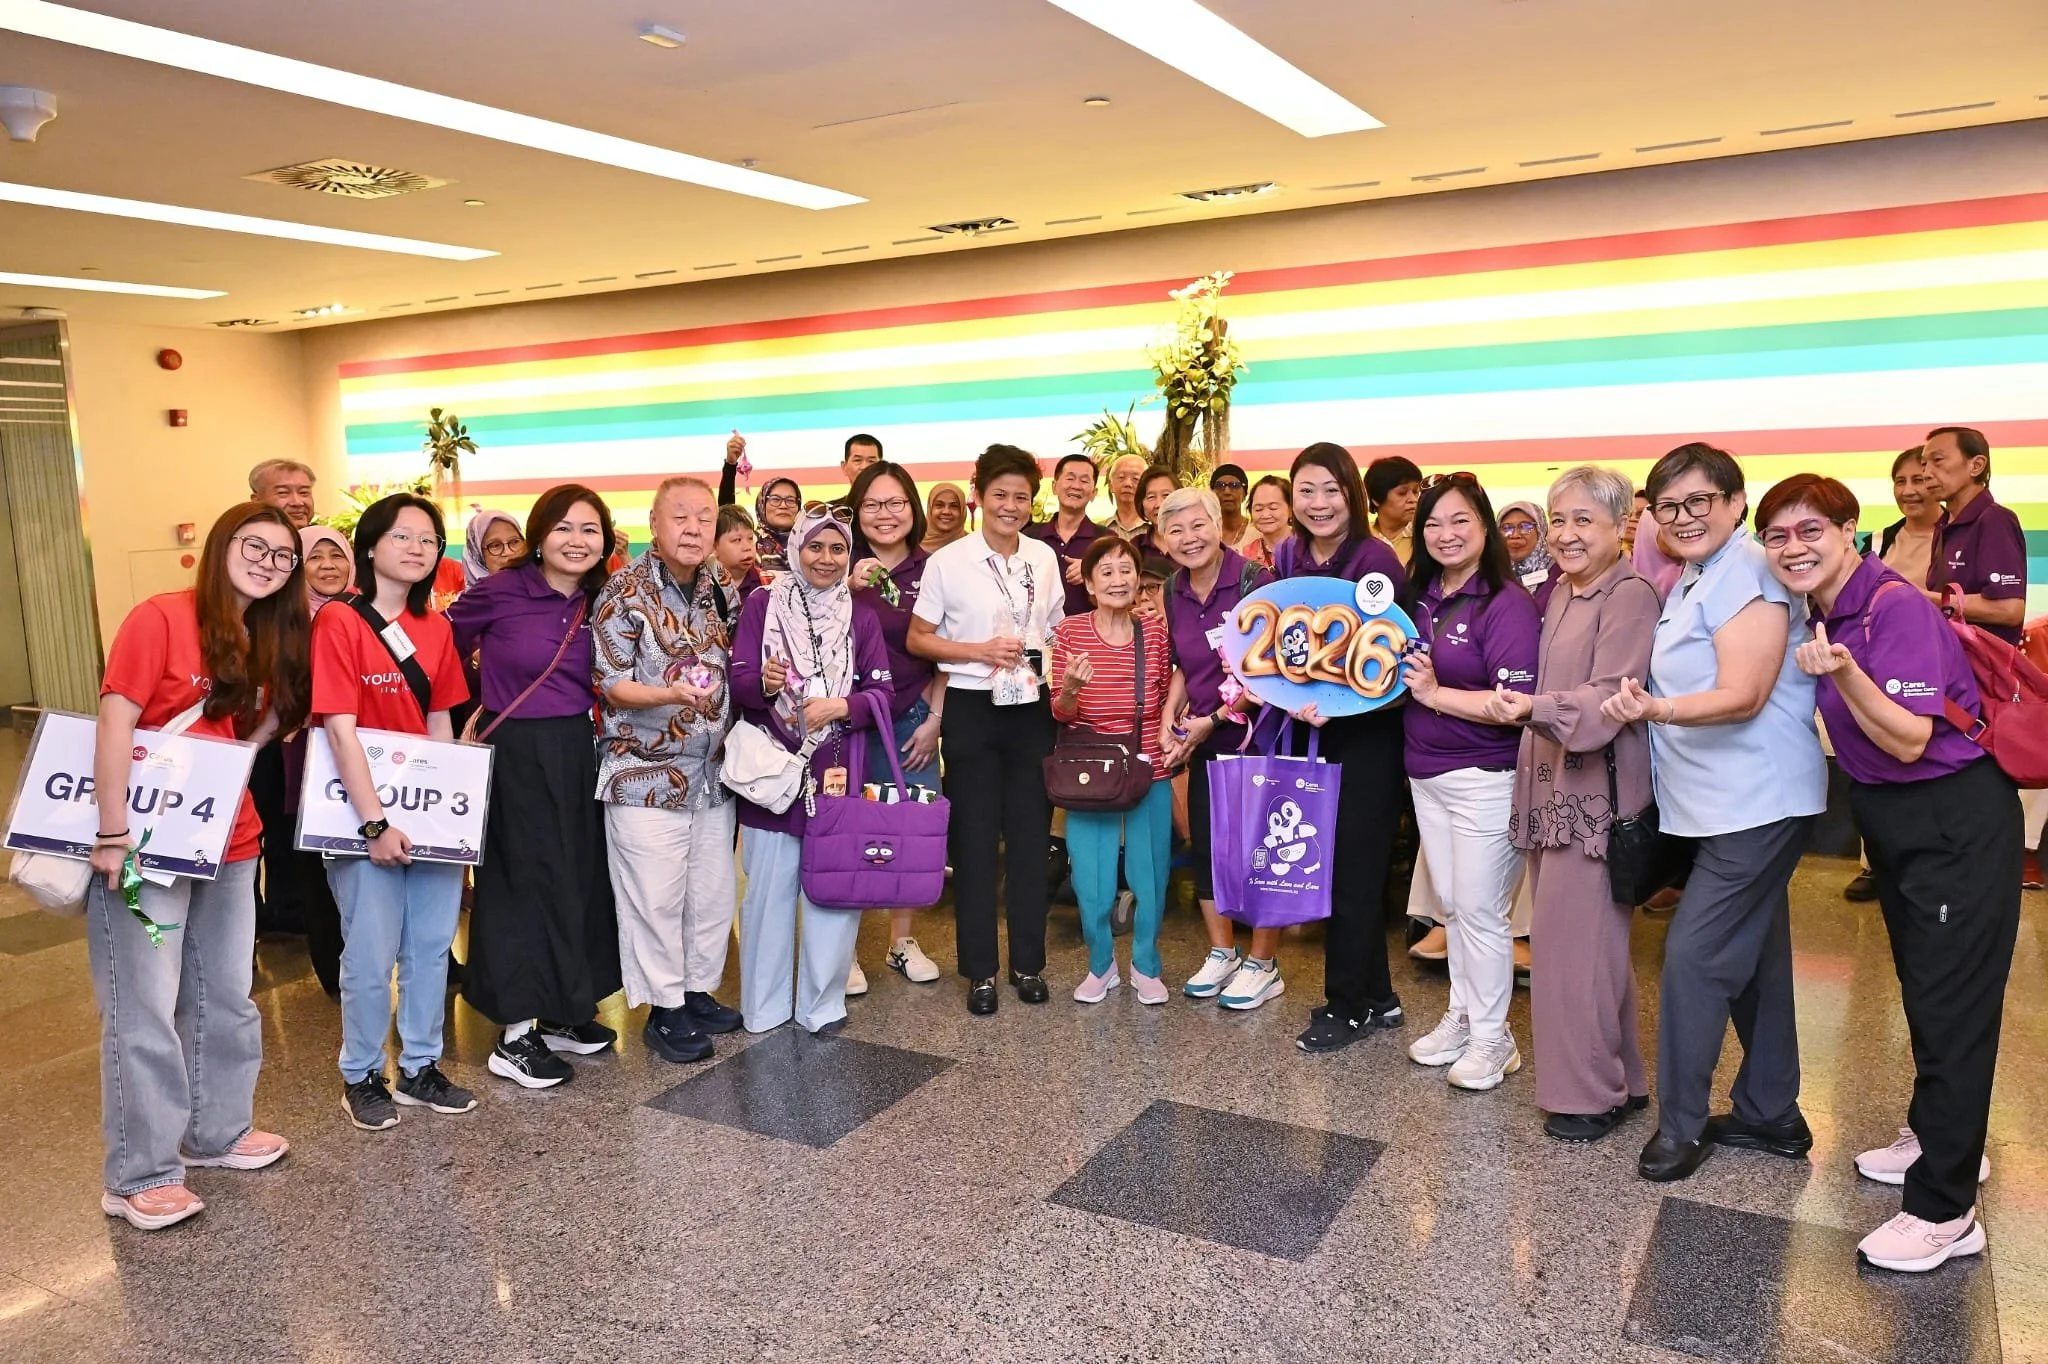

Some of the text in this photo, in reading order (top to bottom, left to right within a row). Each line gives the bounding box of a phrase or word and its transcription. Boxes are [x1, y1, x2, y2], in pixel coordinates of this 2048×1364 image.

[1238, 599, 1407, 698] 2026
[1902, 681, 1926, 689] Cares
[45, 772, 215, 822] GRUP 4
[324, 778, 469, 816] GOUP 3
